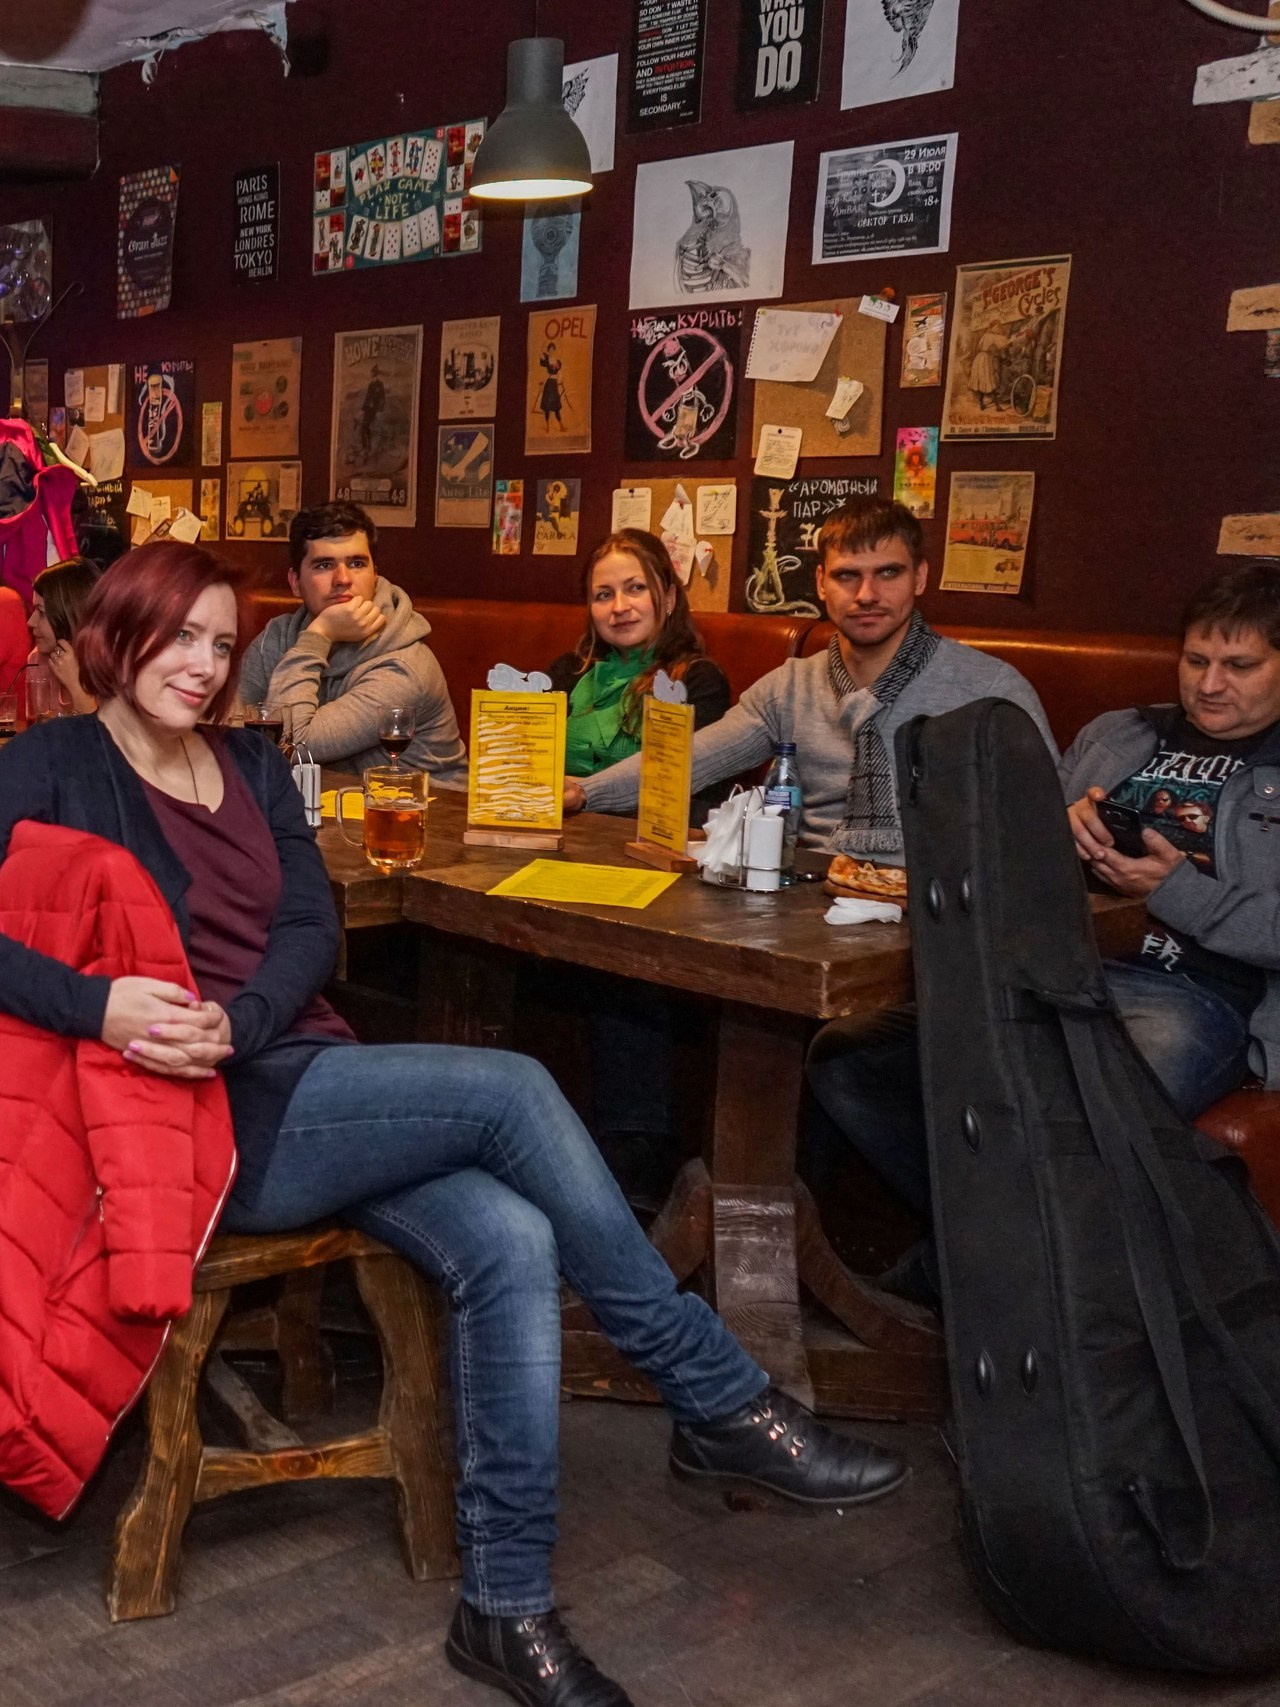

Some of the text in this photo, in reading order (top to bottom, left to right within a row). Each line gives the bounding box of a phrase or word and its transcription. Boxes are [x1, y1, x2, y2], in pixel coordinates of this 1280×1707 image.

[759, 6, 804, 46] YOU
[636, 57, 660, 68] FOLLOW
[660, 53, 676, 61] YOUR
[676, 49, 696, 58] HEART
[636, 67, 653, 79] AND
[755, 40, 802, 98] DO
[660, 93, 668, 102] IS
[904, 149, 916, 161] 29
[236, 174, 268, 196] PARIS
[398, 178, 434, 194] GAME
[384, 193, 404, 206] NOT
[923, 195, 940, 207] 18+
[240, 200, 275, 223] ROME
[375, 202, 409, 220] LIFE
[240, 223, 272, 238] NEW YORK
[235, 234, 275, 253] LONDRES
[234, 249, 273, 270] TOKYO
[248, 265, 273, 278] BERLIN
[544, 317, 588, 340] OPEL
[344, 335, 380, 364] HOWE
[134, 364, 149, 384] НЕ
[337, 487, 351, 501] 48
[391, 487, 406, 501] 48
